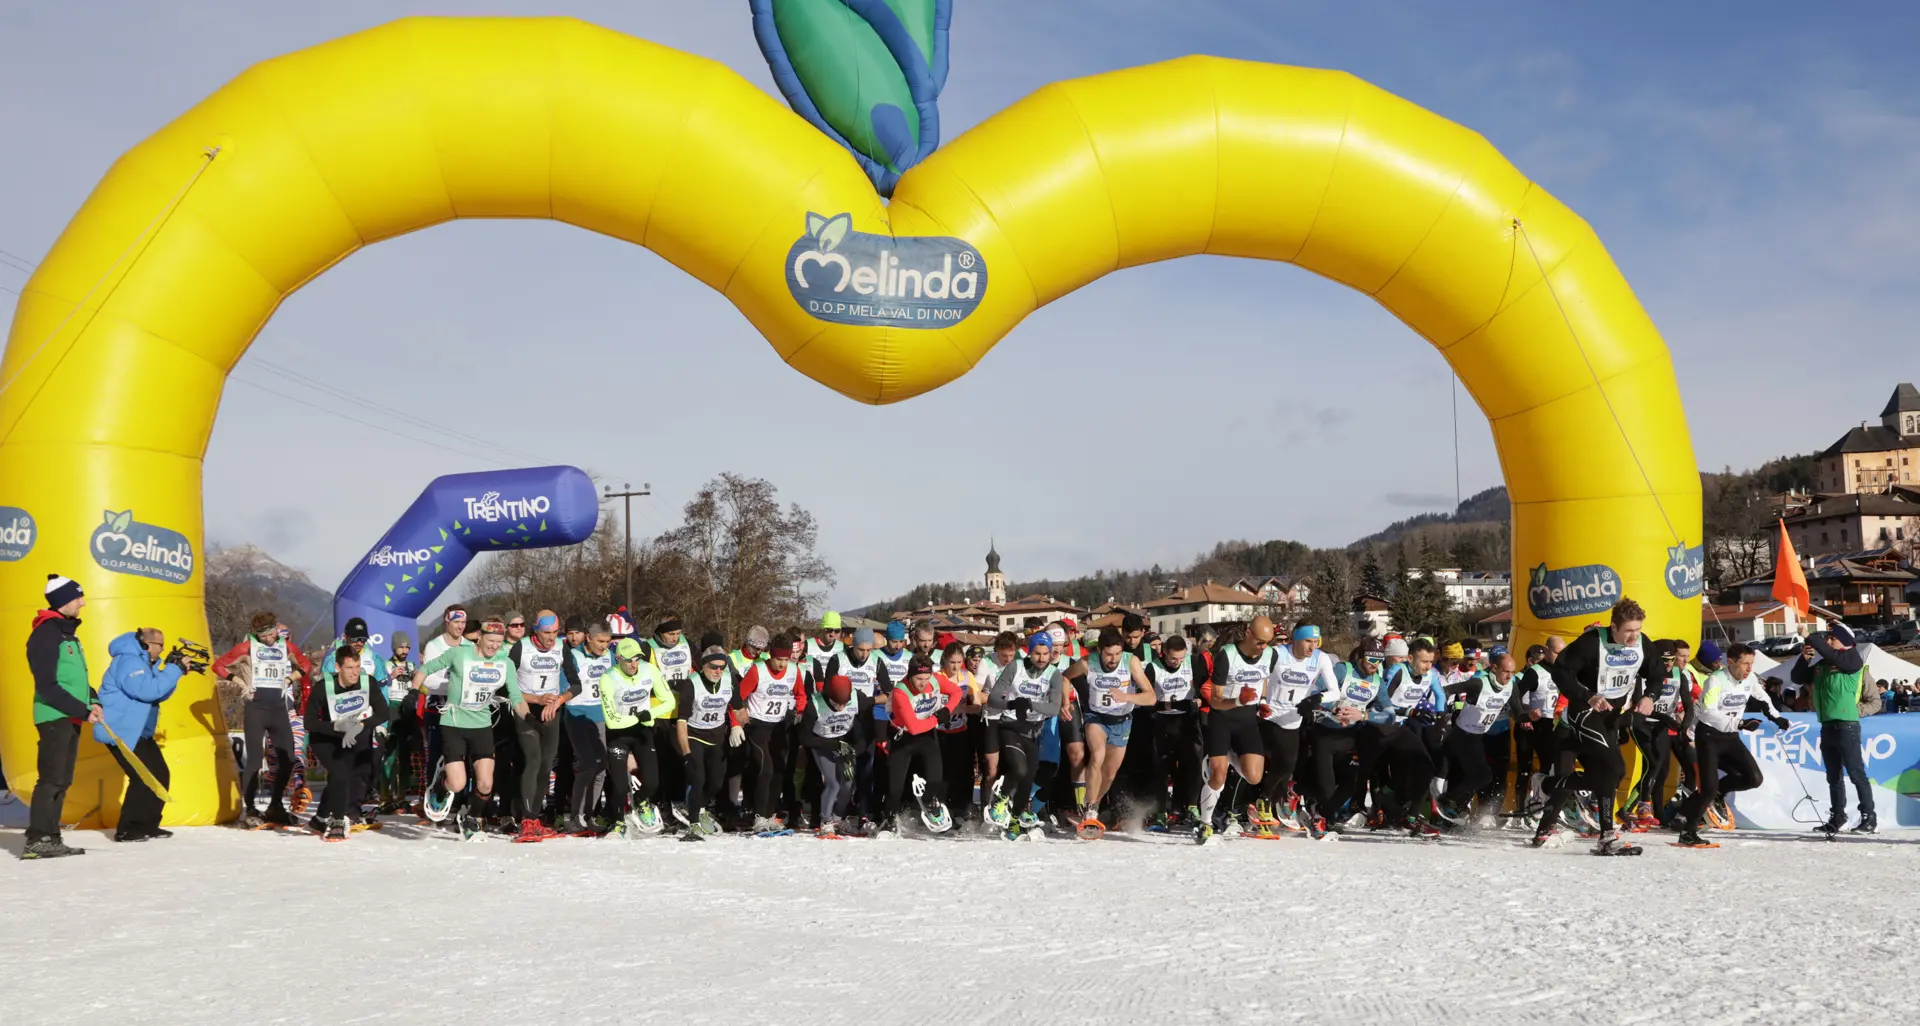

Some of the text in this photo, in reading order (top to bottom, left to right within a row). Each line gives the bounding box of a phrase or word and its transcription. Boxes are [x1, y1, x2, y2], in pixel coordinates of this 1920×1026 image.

[794, 250, 978, 299] Melinda
[809, 300, 962, 320] D.O.P MELA VAL DI NON
[463, 495, 550, 522] TRENTINO
[96, 531, 192, 571] Melinda
[369, 548, 431, 566] TRENTINO
[127, 561, 150, 573] MELA
[150, 566, 164, 576] VAL
[165, 569, 173, 577] DI
[1530, 573, 1617, 606] Melinda
[1594, 600, 1612, 608] NON
[1606, 652, 1637, 663] Melinda
[264, 668, 278, 678] 170
[470, 671, 500, 681] Melinda
[539, 675, 547, 689] 7
[1611, 674, 1629, 687] 104
[475, 691, 491, 702] 157
[1102, 693, 1111, 707] 5
[1287, 689, 1295, 701] 1
[765, 701, 782, 715] 23
[1654, 703, 1668, 712] 163
[1482, 713, 1496, 726] 49
